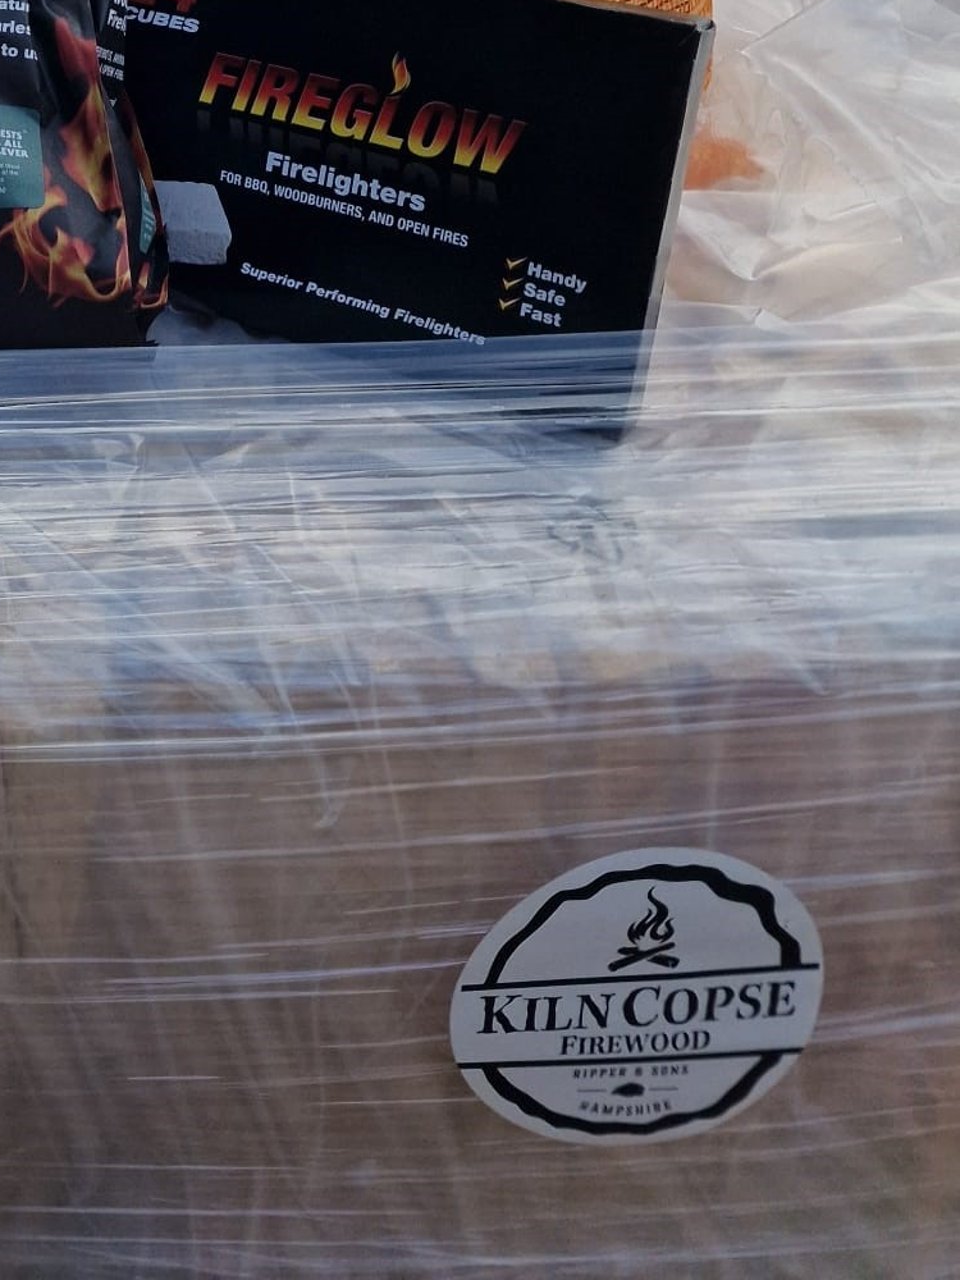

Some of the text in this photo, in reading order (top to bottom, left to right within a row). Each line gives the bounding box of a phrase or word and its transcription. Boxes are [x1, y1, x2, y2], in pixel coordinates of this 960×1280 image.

[126, 5, 200, 34] CUBES
[1, 42, 18, 58] to
[198, 51, 527, 175] FIREGLOW
[3, 139, 24, 149] ALL
[265, 150, 426, 212] Firelighters
[220, 169, 469, 248] FOR BBQ, WOODBURNERS, AND OPEN FIRES
[527, 261, 587, 294] Handy
[240, 262, 486, 346] Superior Performing Firelighters
[523, 282, 566, 307] Safe
[520, 302, 562, 327] Fast
[560, 1030, 711, 1057] FIREWOOD
